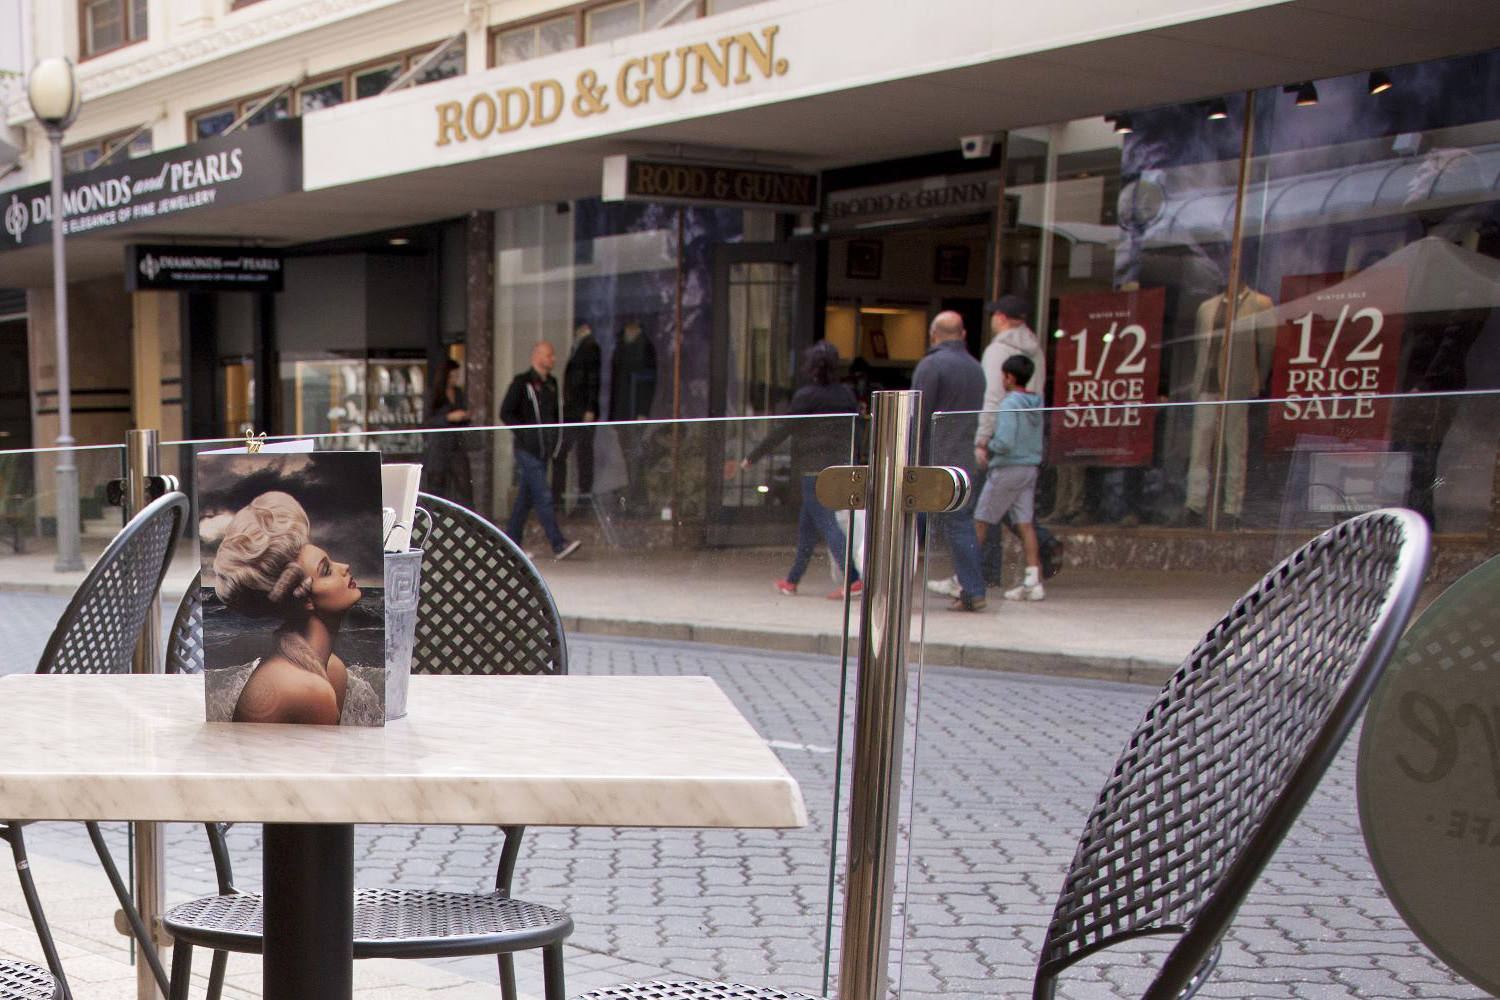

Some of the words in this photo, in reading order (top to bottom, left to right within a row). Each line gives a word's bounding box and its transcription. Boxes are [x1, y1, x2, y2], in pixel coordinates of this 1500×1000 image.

[436, 79, 564, 147] RODD
[571, 68, 609, 118] &
[616, 25, 789, 108] GUNN.
[32, 175, 132, 225] DIMONDS
[132, 161, 170, 196] and
[171, 148, 243, 192] PEARLS
[636, 164, 708, 195] RODD
[713, 169, 729, 199] &
[734, 171, 810, 204] GUNN
[831, 194, 895, 217] RODD
[916, 181, 989, 208] GUNN
[118, 206, 132, 222] OF
[133, 201, 156, 219] FINE
[1067, 321, 1148, 380] 1/2
[1288, 303, 1384, 369] 1/2
[1066, 378, 1145, 403] PRICE
[1286, 366, 1380, 392] PRICE
[1063, 401, 1143, 428] SALE
[1283, 390, 1379, 421] SALE
